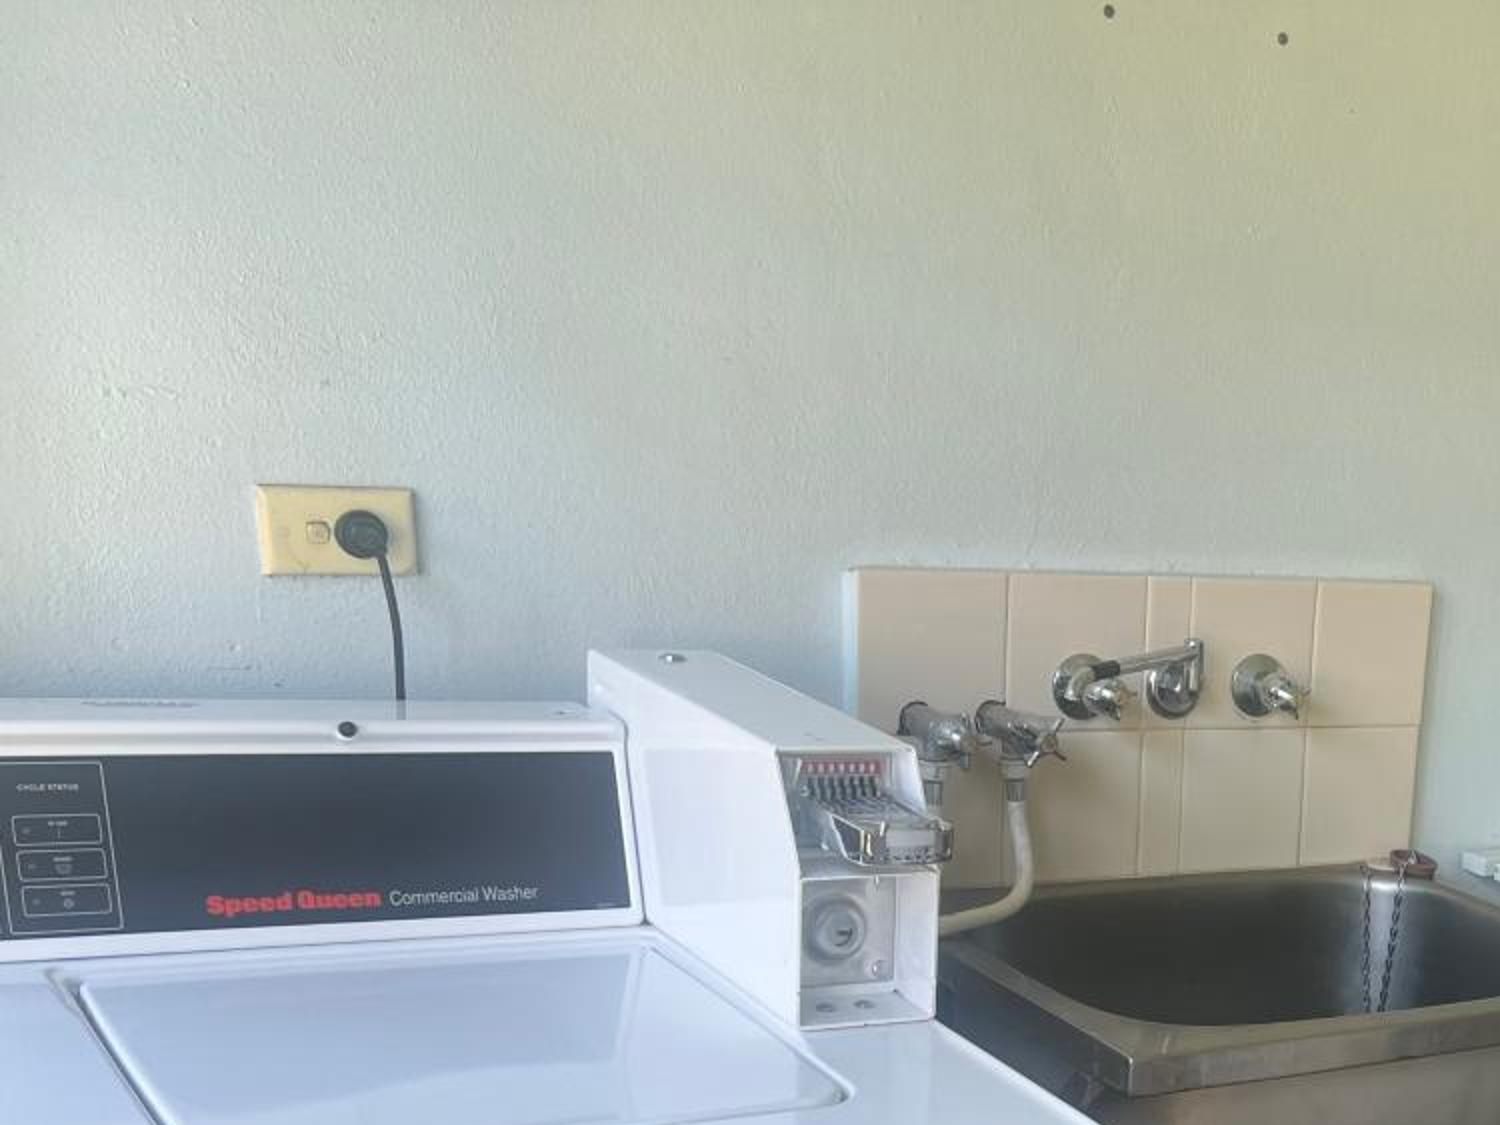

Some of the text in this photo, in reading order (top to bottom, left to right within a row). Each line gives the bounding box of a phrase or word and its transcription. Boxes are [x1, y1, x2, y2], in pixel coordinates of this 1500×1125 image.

[16, 783, 80, 792] CYCLE STATUS
[207, 885, 539, 918] Speed Queen Commercial Washer
